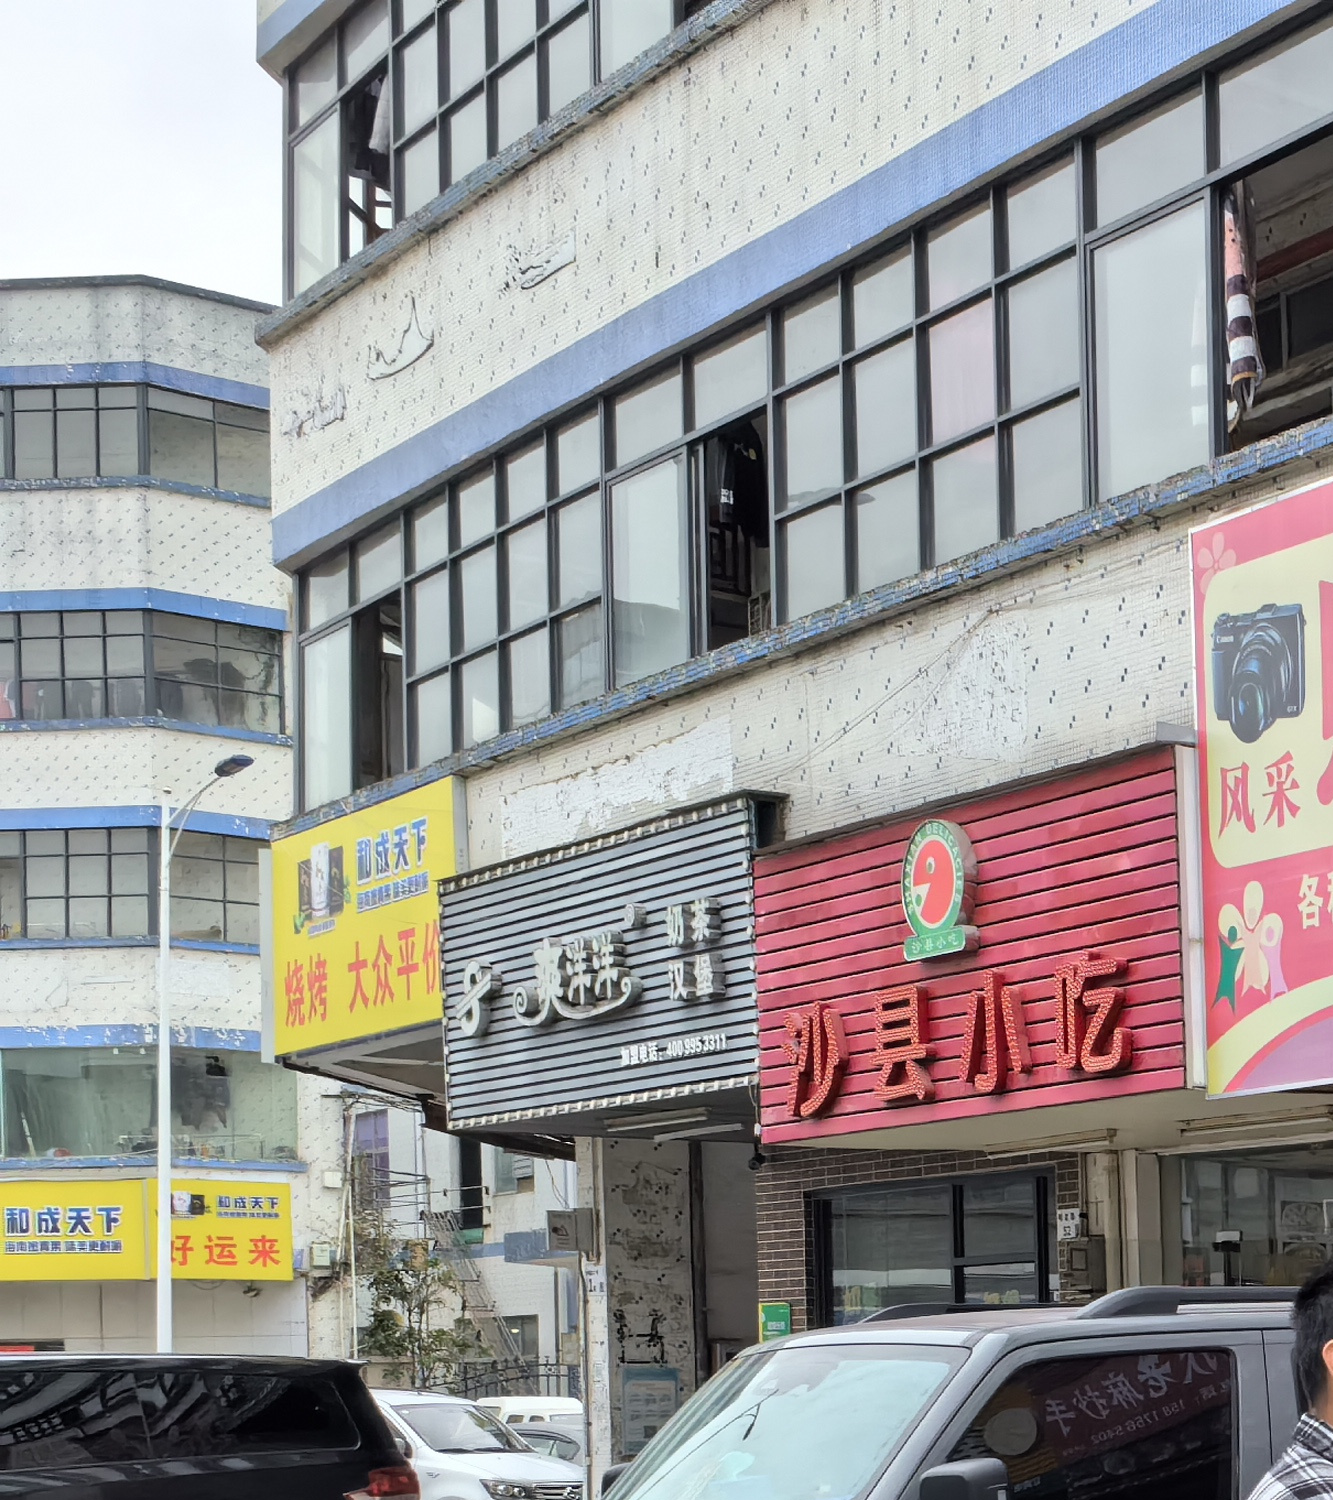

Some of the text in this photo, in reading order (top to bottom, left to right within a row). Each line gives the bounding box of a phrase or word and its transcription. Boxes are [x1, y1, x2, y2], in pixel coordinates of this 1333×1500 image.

[1216, 750, 1302, 840] 风采
[285, 952, 328, 1028] 烧烤
[782, 952, 1132, 1118] 沙县小吃
[4, 1206, 124, 1238] 和成天下
